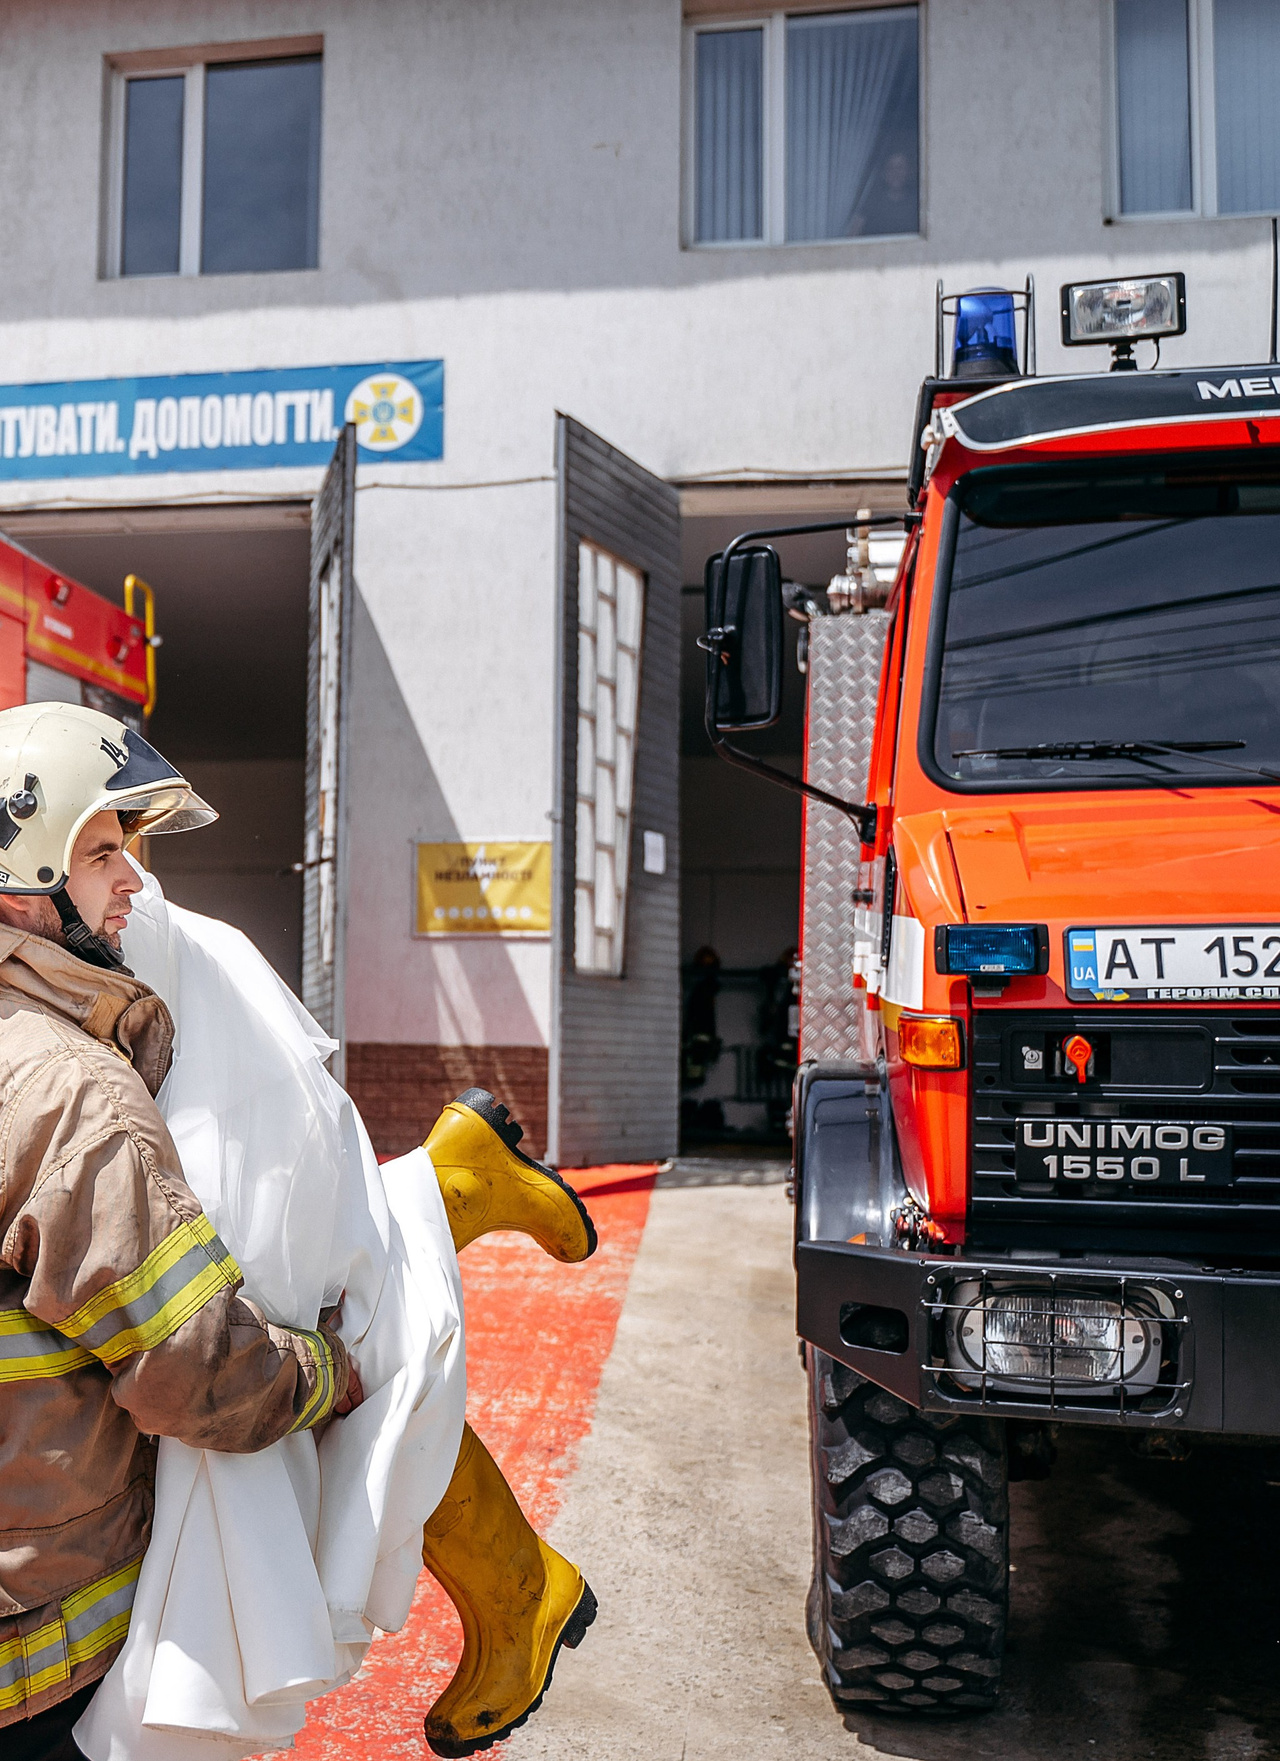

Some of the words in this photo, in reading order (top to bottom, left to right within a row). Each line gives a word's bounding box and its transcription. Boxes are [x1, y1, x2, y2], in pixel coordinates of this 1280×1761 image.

[1197, 376, 1280, 400] ME
[129, 388, 340, 460] ДОПОМОГТИ.
[100, 736, 129, 769] 14
[1203, 936, 1280, 978] 152
[1073, 966, 1096, 981] UA
[1146, 987, 1240, 1000] ГЕРОЯМ
[1023, 1123, 1226, 1151] UNIMOG
[1042, 1155, 1160, 1180] 1550
[1179, 1158, 1206, 1182] L
